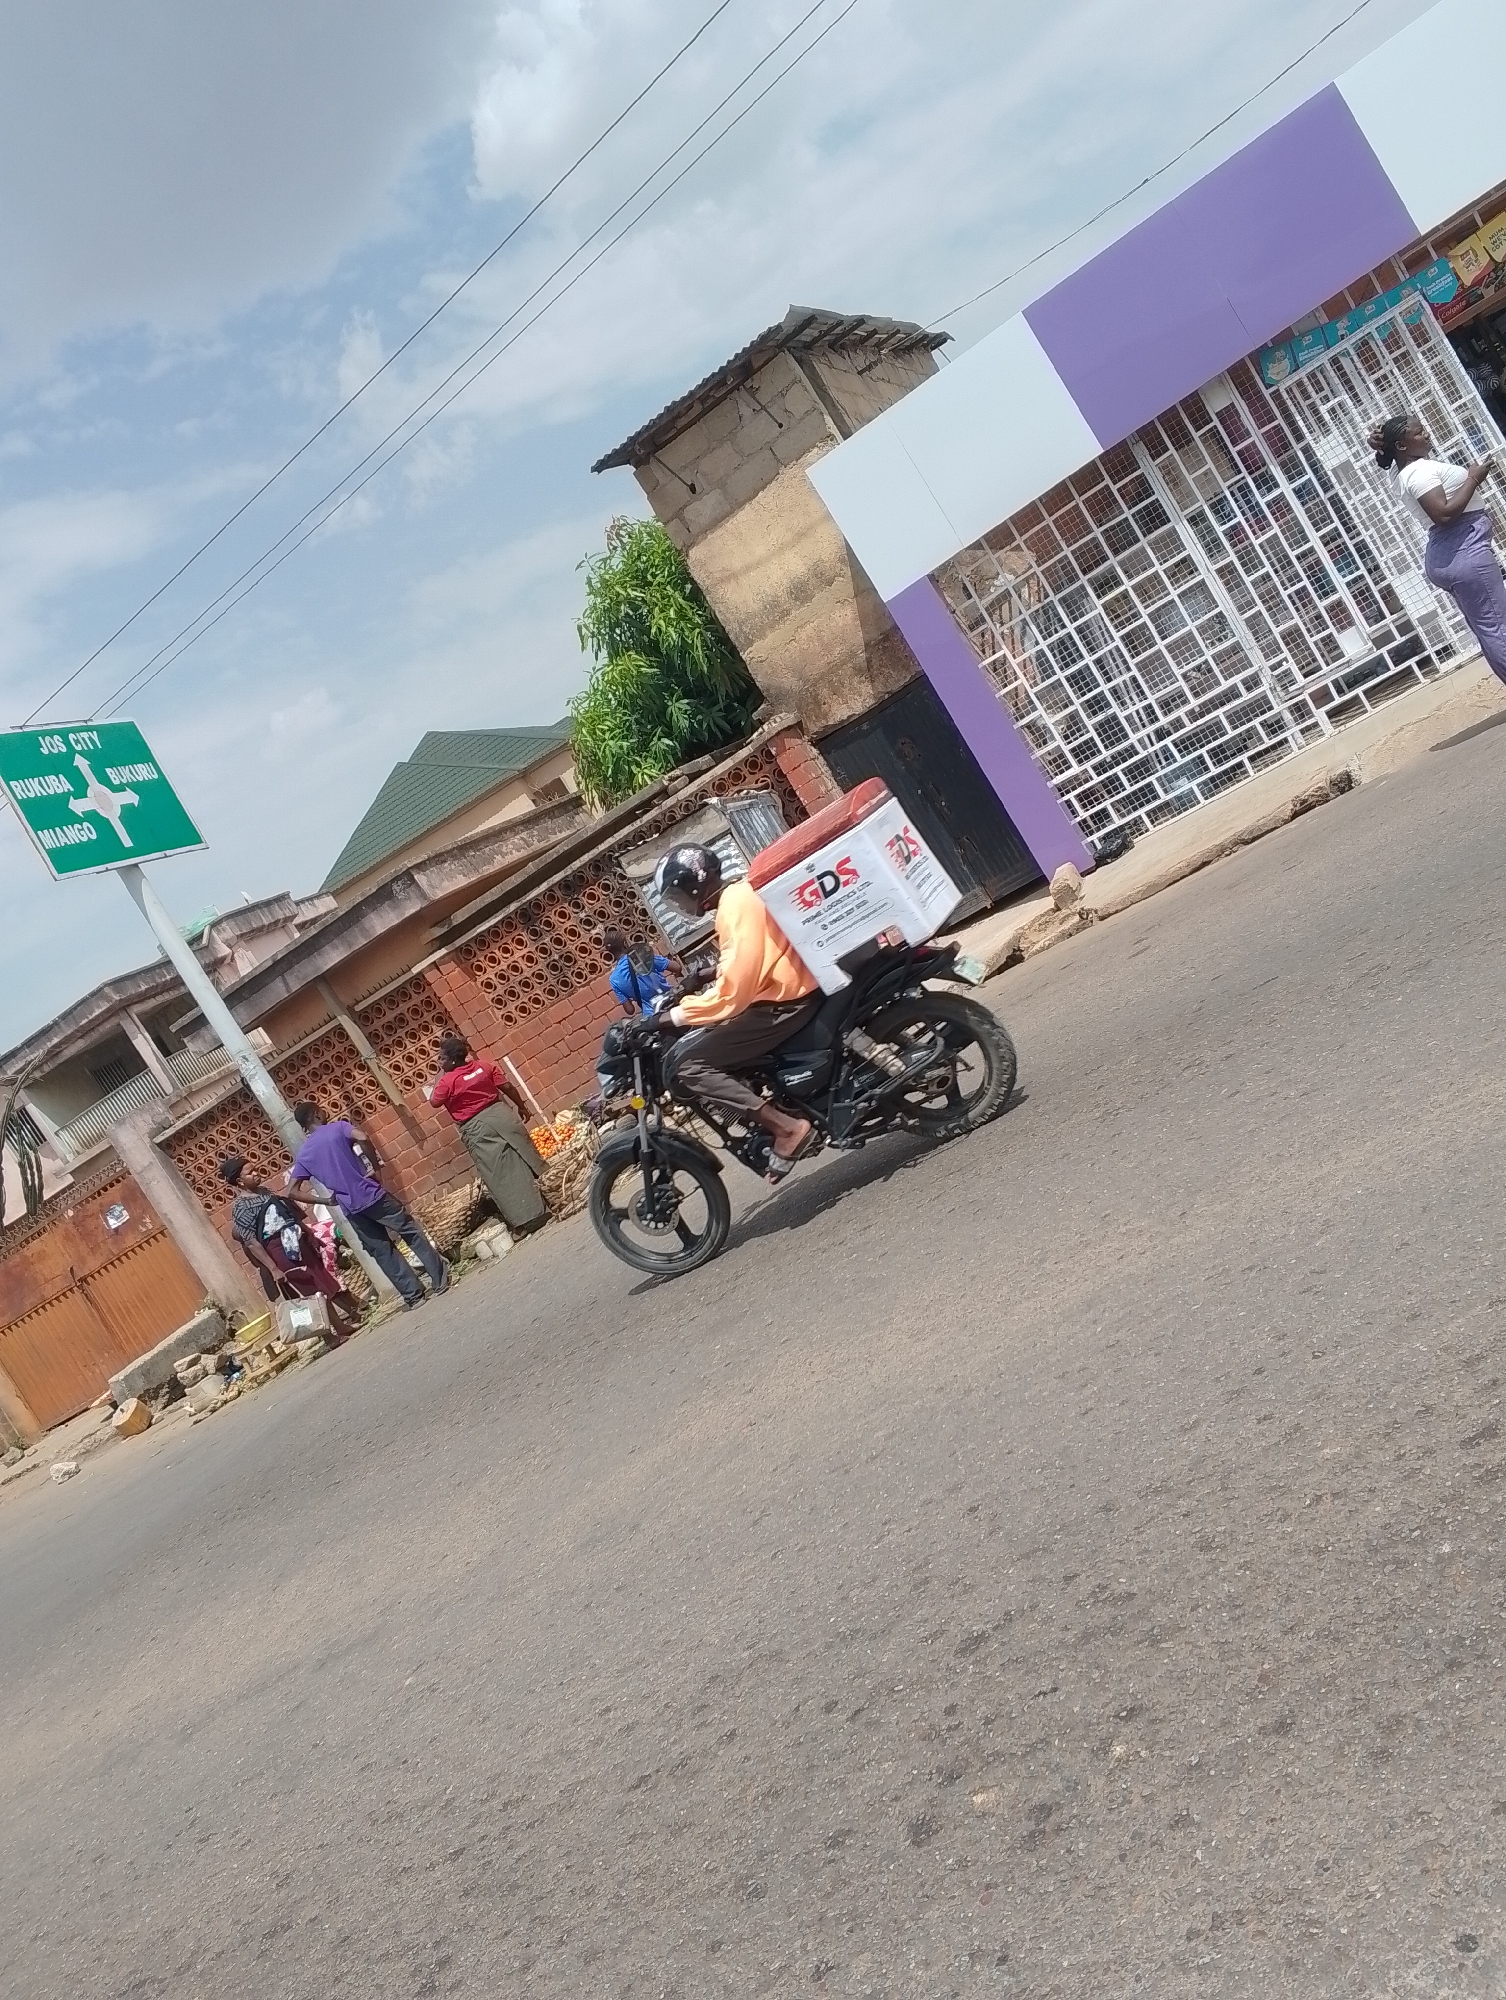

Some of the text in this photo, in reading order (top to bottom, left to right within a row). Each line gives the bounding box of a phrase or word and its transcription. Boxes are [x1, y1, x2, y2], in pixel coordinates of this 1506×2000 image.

[1441, 299, 1467, 318] Colgate
[38, 730, 102, 754] JOS CITY
[9, 773, 74, 800] RUKUBA
[104, 762, 159, 785] BUKURU
[37, 821, 97, 849] MIANGO
[792, 855, 861, 910] GDS
[801, 910, 823, 926] PRIME
[823, 889, 857, 912] LOGISTICS
